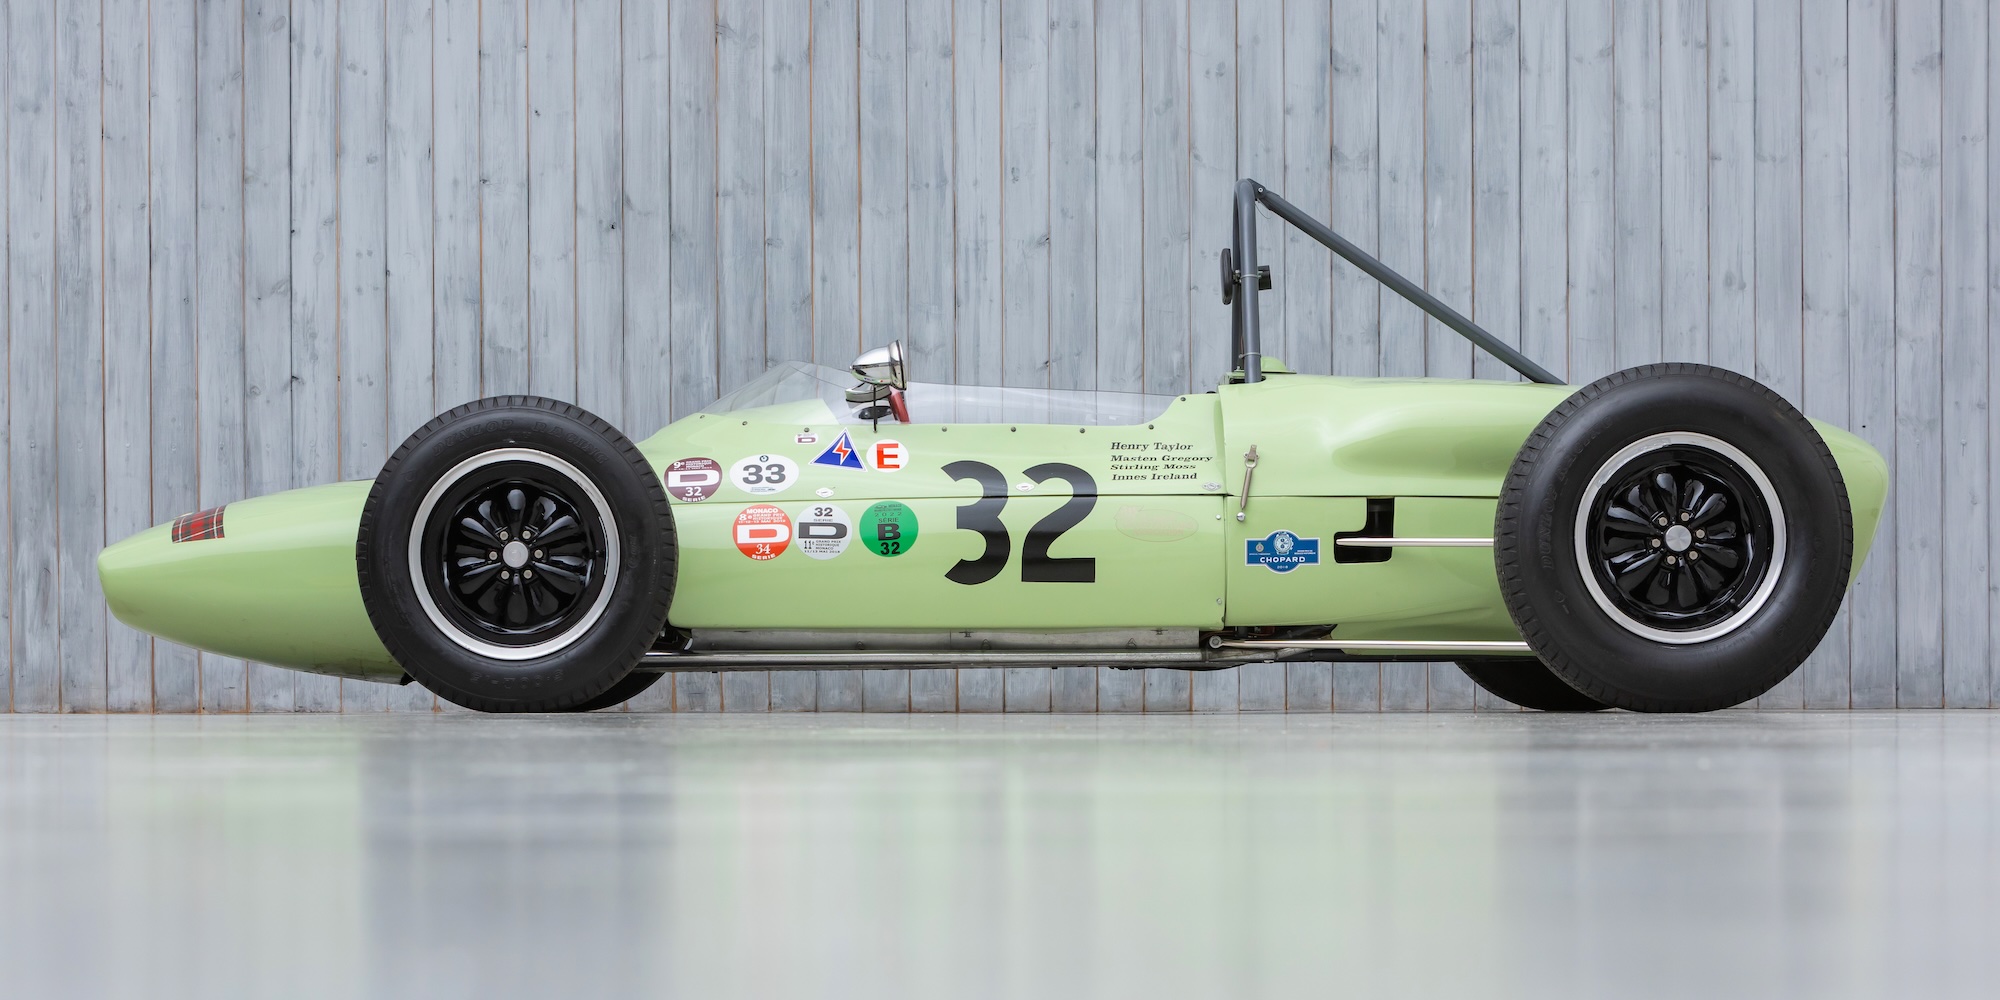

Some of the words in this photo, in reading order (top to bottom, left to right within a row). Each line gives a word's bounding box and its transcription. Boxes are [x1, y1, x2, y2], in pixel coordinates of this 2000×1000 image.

[876, 443, 900, 469] E
[1110, 442, 1149, 452] Henry
[1153, 442, 1194, 452] Taylor
[668, 470, 720, 488] D
[742, 463, 786, 485] 33
[1111, 473, 1147, 481] Innes
[1150, 472, 1198, 480] Ireland
[685, 486, 702, 497] 32
[814, 507, 833, 517] 32
[798, 522, 848, 540] D
[877, 523, 901, 541] B
[941, 460, 1098, 586] 32
[736, 523, 790, 544] D
[755, 543, 771, 555] 34
[880, 541, 901, 555] 32
